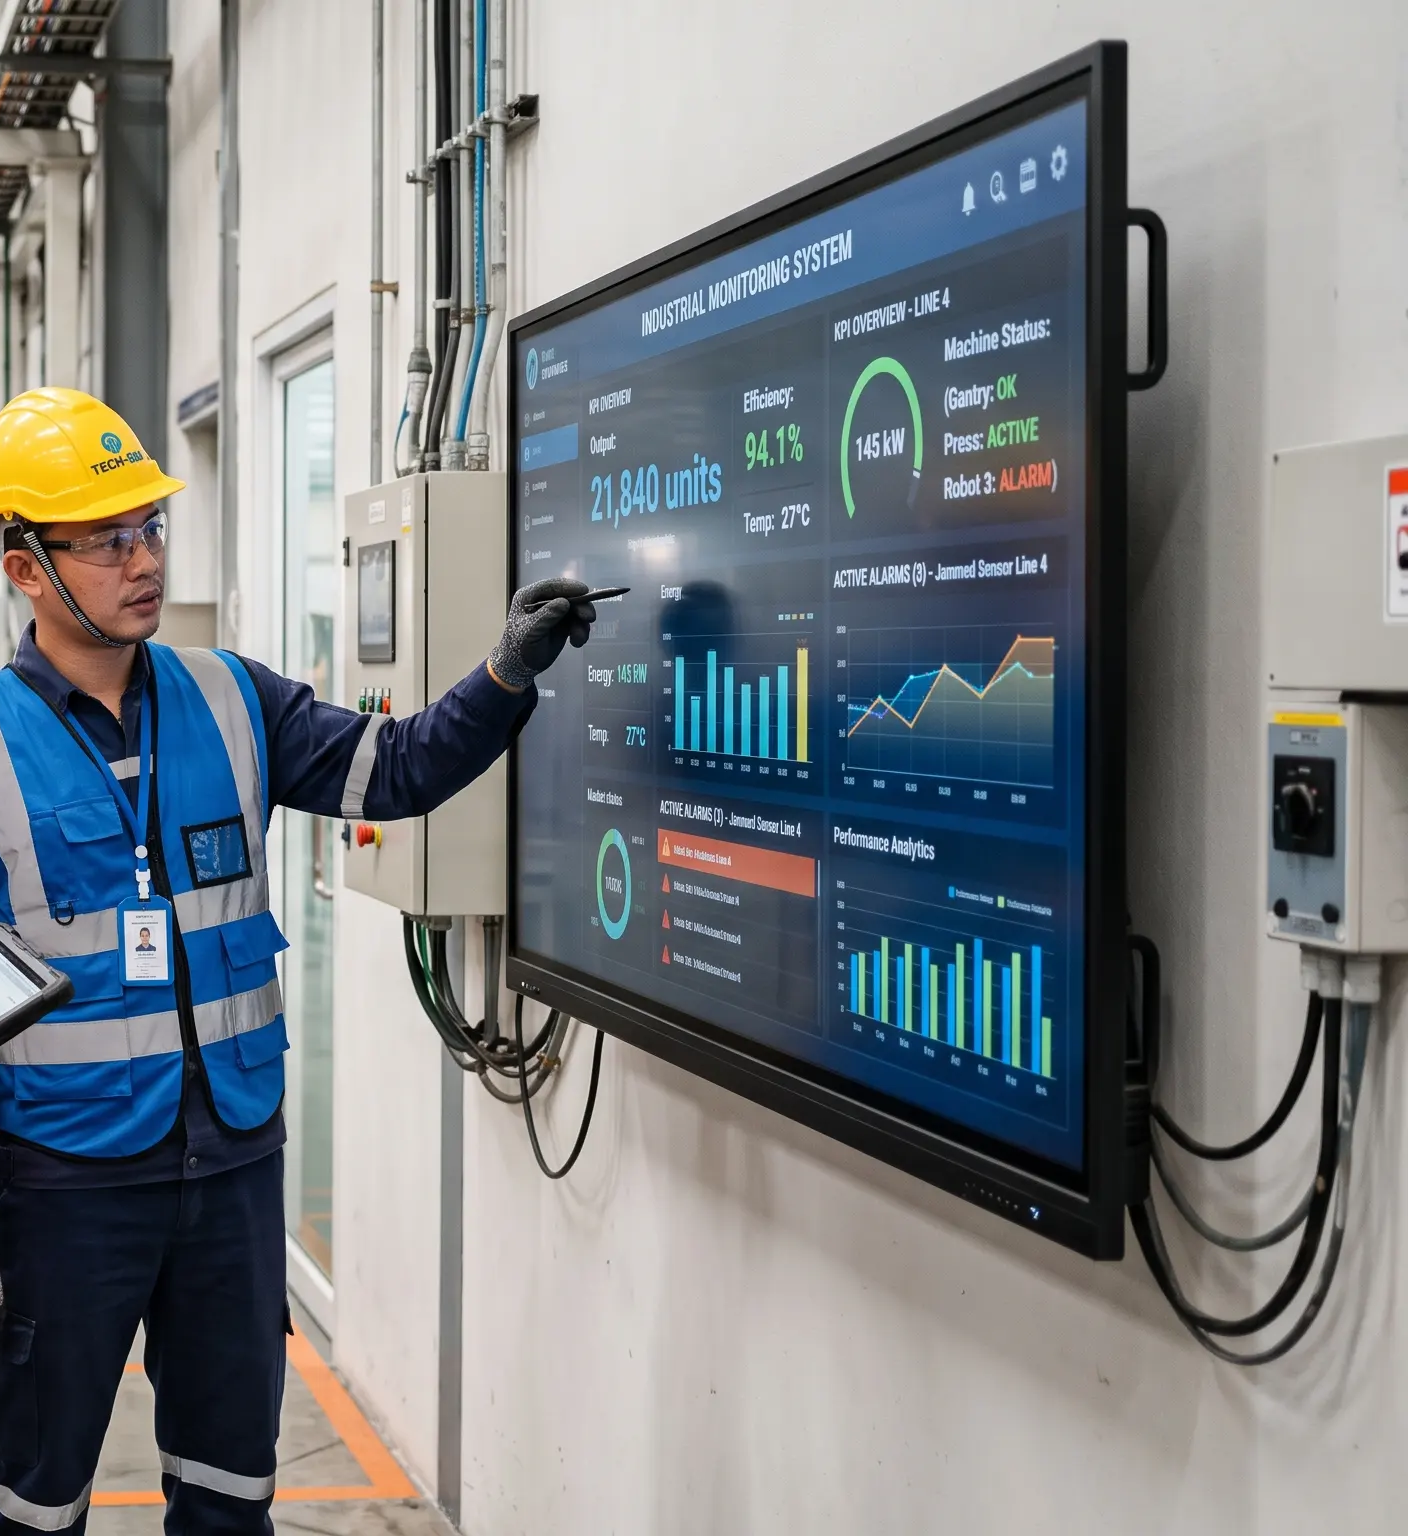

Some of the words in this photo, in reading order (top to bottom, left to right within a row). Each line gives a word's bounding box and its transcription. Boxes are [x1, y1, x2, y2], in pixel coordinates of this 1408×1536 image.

[641, 289, 706, 337] INDUSTRIAL
[708, 254, 790, 312] MONITORING
[793, 229, 852, 279] SYSTEM
[833, 319, 850, 341] KPI
[852, 301, 906, 336] OVERVIEW
[914, 290, 940, 317] LINE
[942, 287, 950, 308] 4
[944, 329, 999, 361] Machine
[1002, 318, 1051, 348] Status:
[743, 386, 794, 414] Efficiency:
[944, 384, 994, 418] (Gantry:
[997, 374, 1017, 401] OK
[745, 423, 803, 471] 94.1%
[856, 432, 879, 462] 145
[883, 427, 905, 457] kW
[944, 432, 984, 456] Press:
[986, 416, 1039, 449] ACTIVE
[591, 463, 659, 530] 21,840
[665, 453, 722, 510] units
[944, 473, 980, 500] Robot
[983, 471, 996, 495] 3:
[999, 458, 1058, 494] ALARM)
[743, 512, 774, 537] Temp:
[781, 503, 810, 530] 27°C
[833, 568, 868, 588] ACTIVE
[869, 564, 911, 586] ALARMS
[912, 562, 926, 587] (3)
[935, 558, 976, 581] Jammed
[978, 556, 1013, 578] Sensor
[1015, 556, 1038, 575] Line
[1040, 554, 1048, 574] 4
[588, 665, 614, 687] Energy:
[659, 800, 683, 817] ACTIVE
[684, 803, 712, 822] ALARMS
[780, 820, 795, 837] Line
[796, 822, 801, 837] 4
[833, 826, 889, 852] Performance
[891, 835, 935, 861] Analytics
